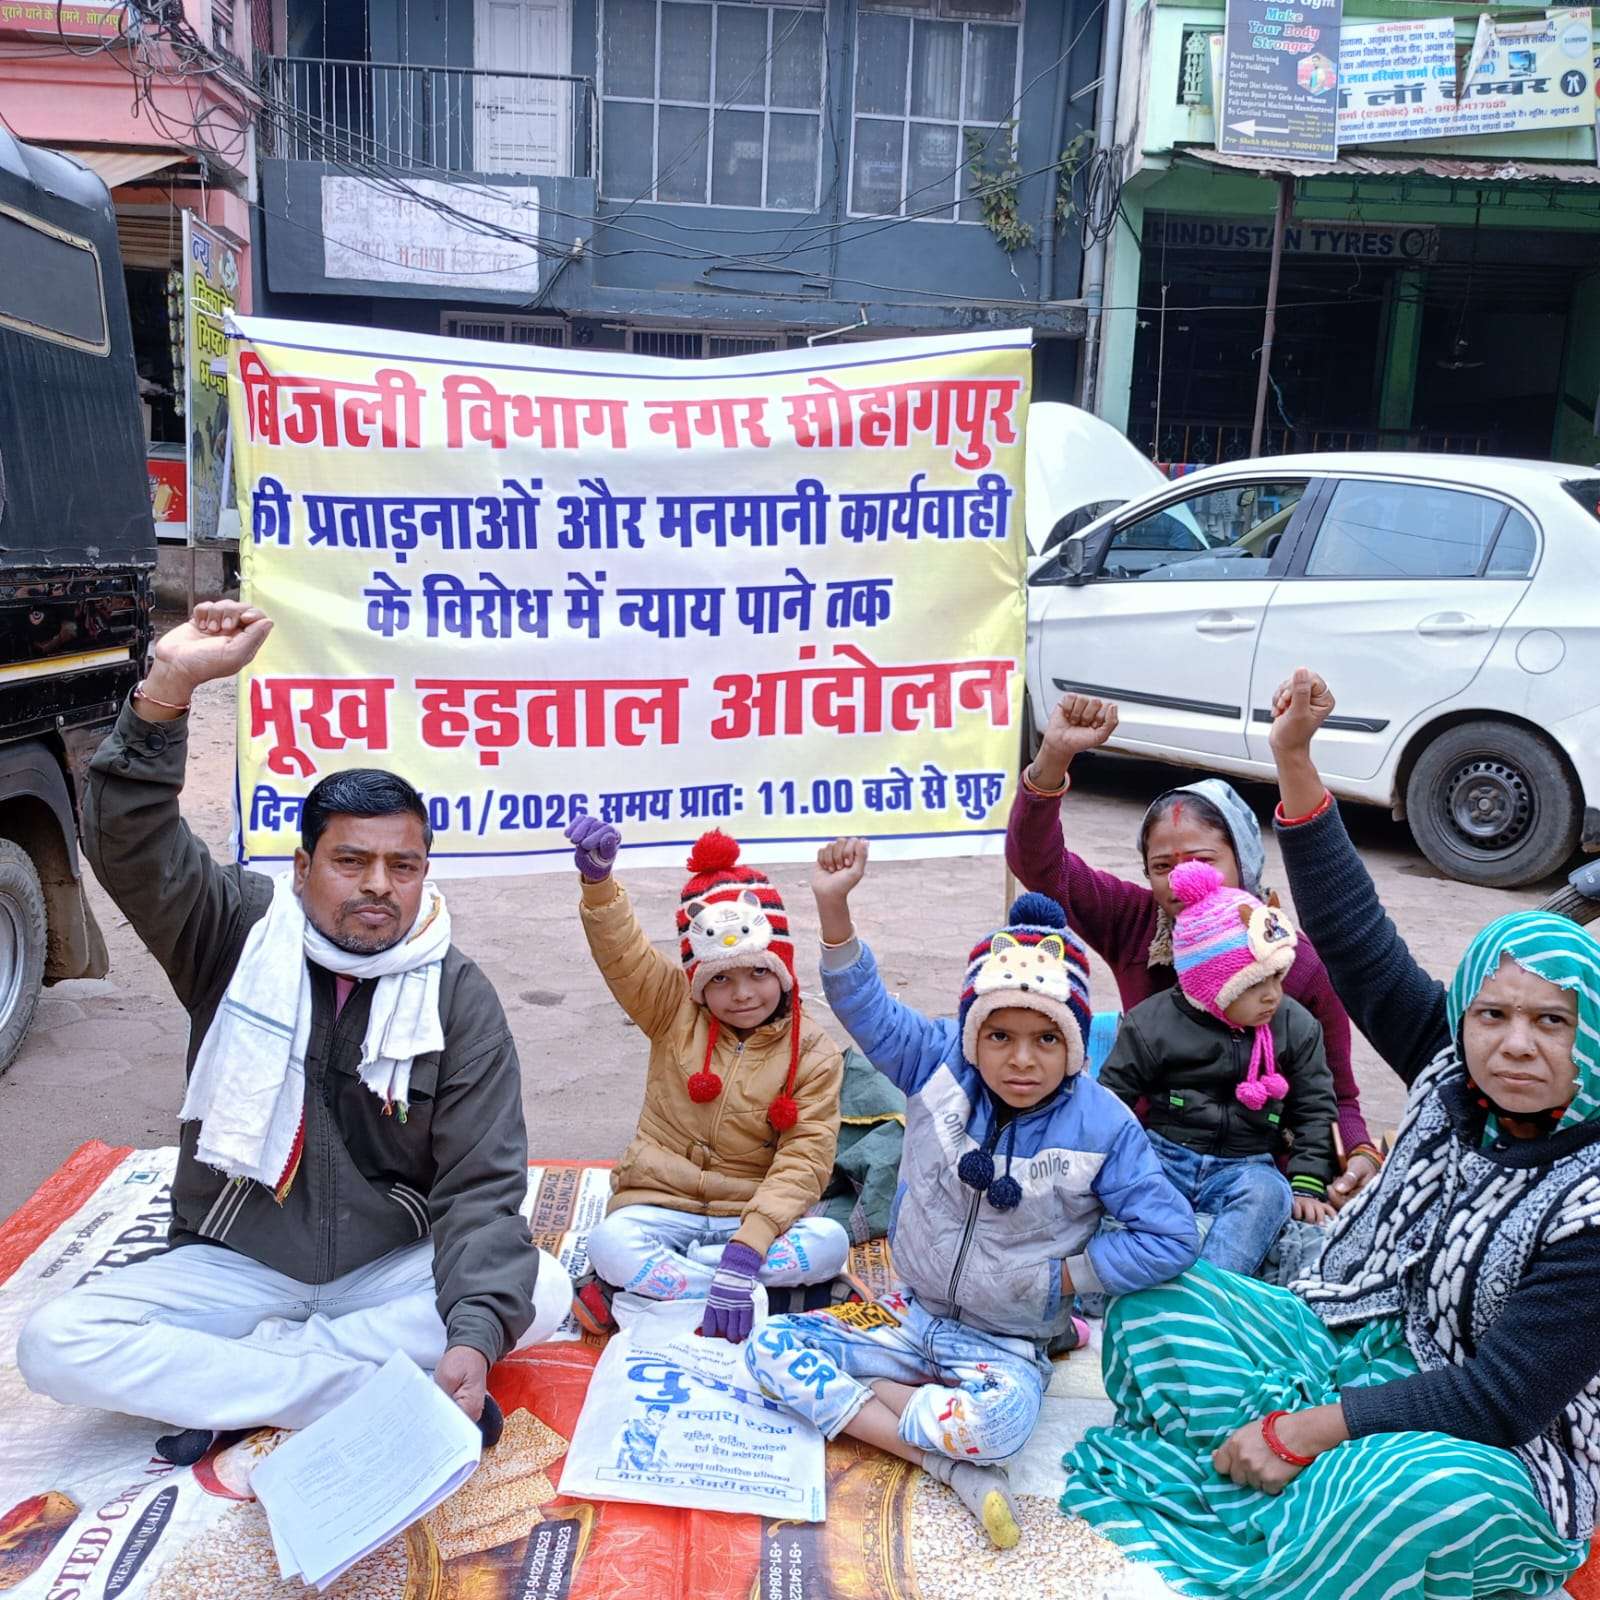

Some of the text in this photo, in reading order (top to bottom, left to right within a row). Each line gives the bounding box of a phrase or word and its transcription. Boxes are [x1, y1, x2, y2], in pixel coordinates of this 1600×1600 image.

[1248, 20, 1320, 41] Your Body
[1264, 7, 1304, 23] Make
[1252, 36, 1315, 55] Stronger
[1310, 229, 1394, 256] TYRES
[240, 351, 1021, 470] बिजली विभाग नगर सोहागपुर
[303, 477, 541, 563] प्रताड़नाओं
[557, 477, 647, 549] और
[656, 478, 831, 548] मनमानी
[838, 473, 1012, 542] कार्यवाही
[364, 567, 893, 639] के विरोध में न्याय पाने तक
[250, 643, 1015, 779] भूख हड़ताल आंदोलन
[599, 788, 673, 824] समय
[757, 779, 853, 816] 11.00
[862, 766, 913, 812] बजे
[920, 764, 947, 809] से
[1030, 1154, 1070, 1181] online
[107, 1536, 145, 1591] PREMIUM
[138, 1492, 173, 1543] QUALITY
[788, 1541, 802, 1600] +91-94122
